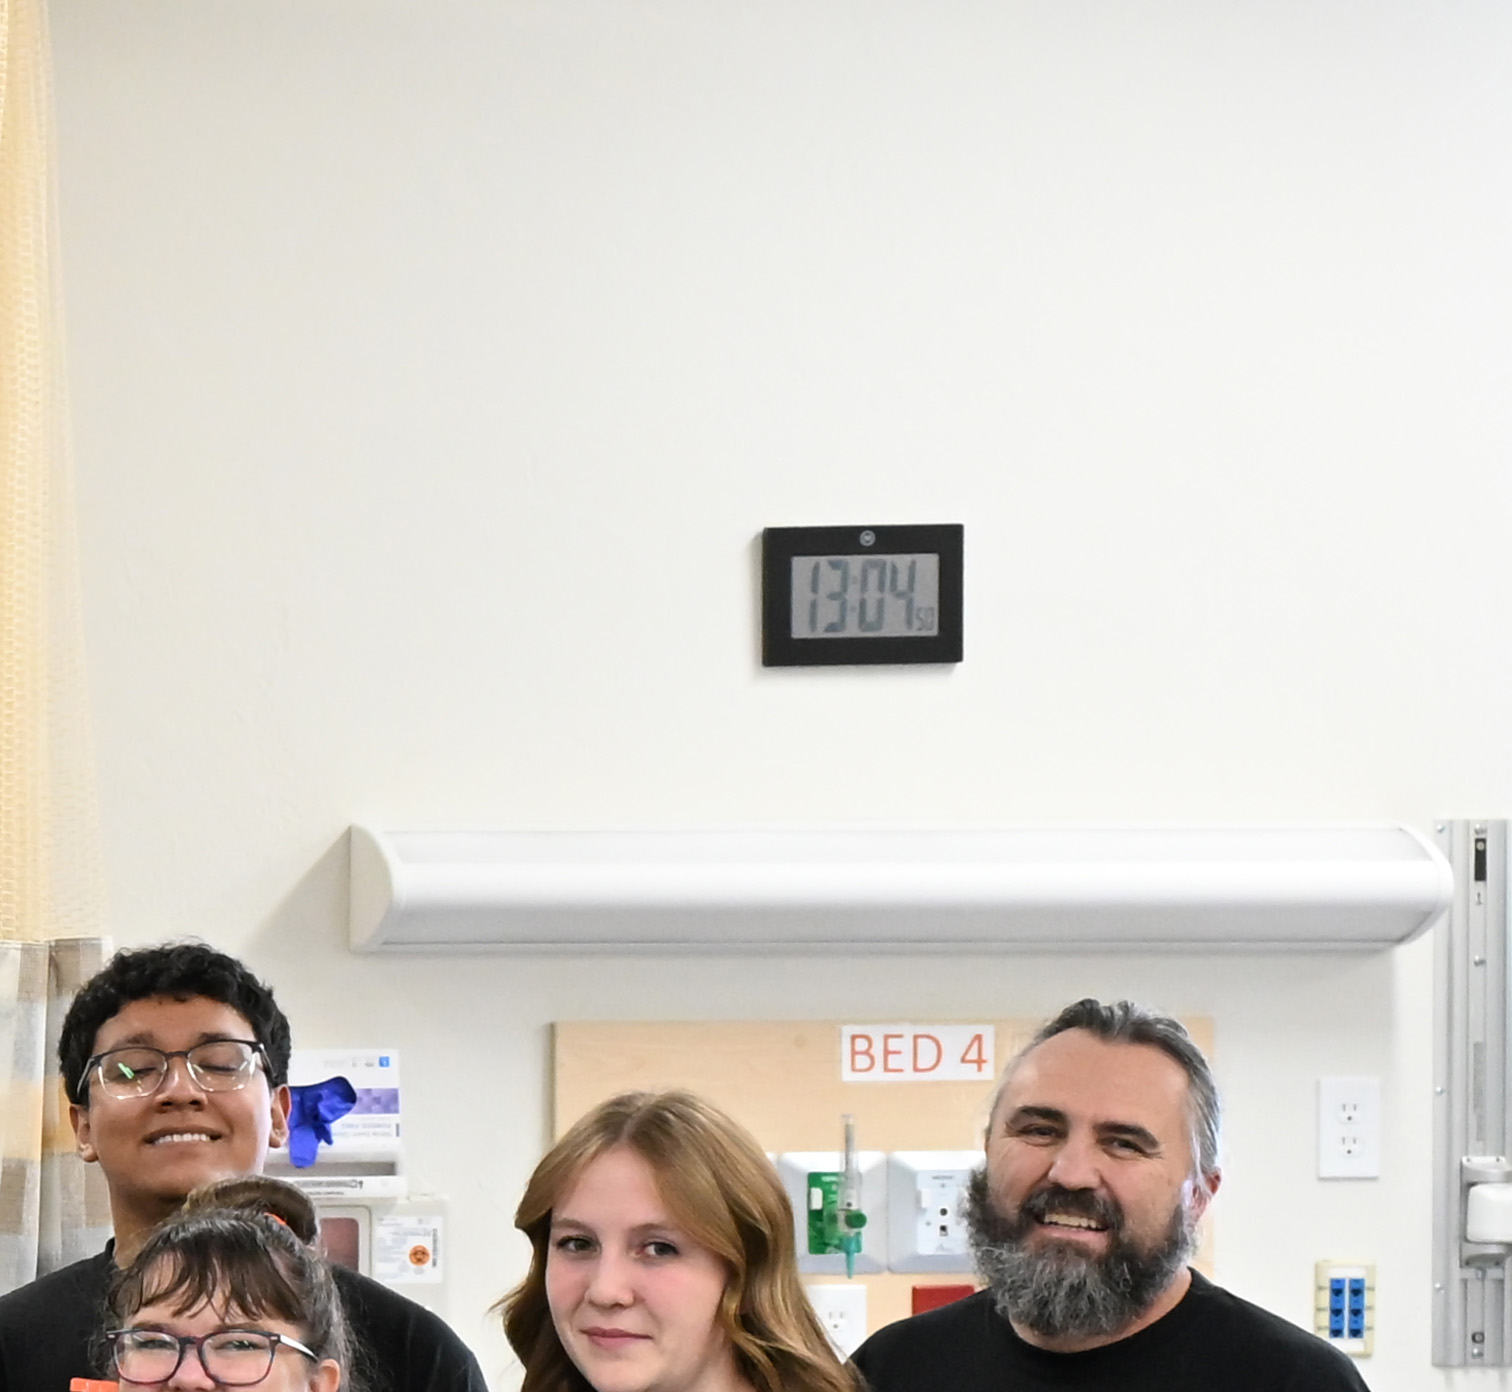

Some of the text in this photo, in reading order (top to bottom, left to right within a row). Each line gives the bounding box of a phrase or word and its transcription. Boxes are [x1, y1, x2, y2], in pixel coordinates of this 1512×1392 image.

[810, 560, 917, 633] 13:04
[850, 1033, 988, 1073] BED 4
